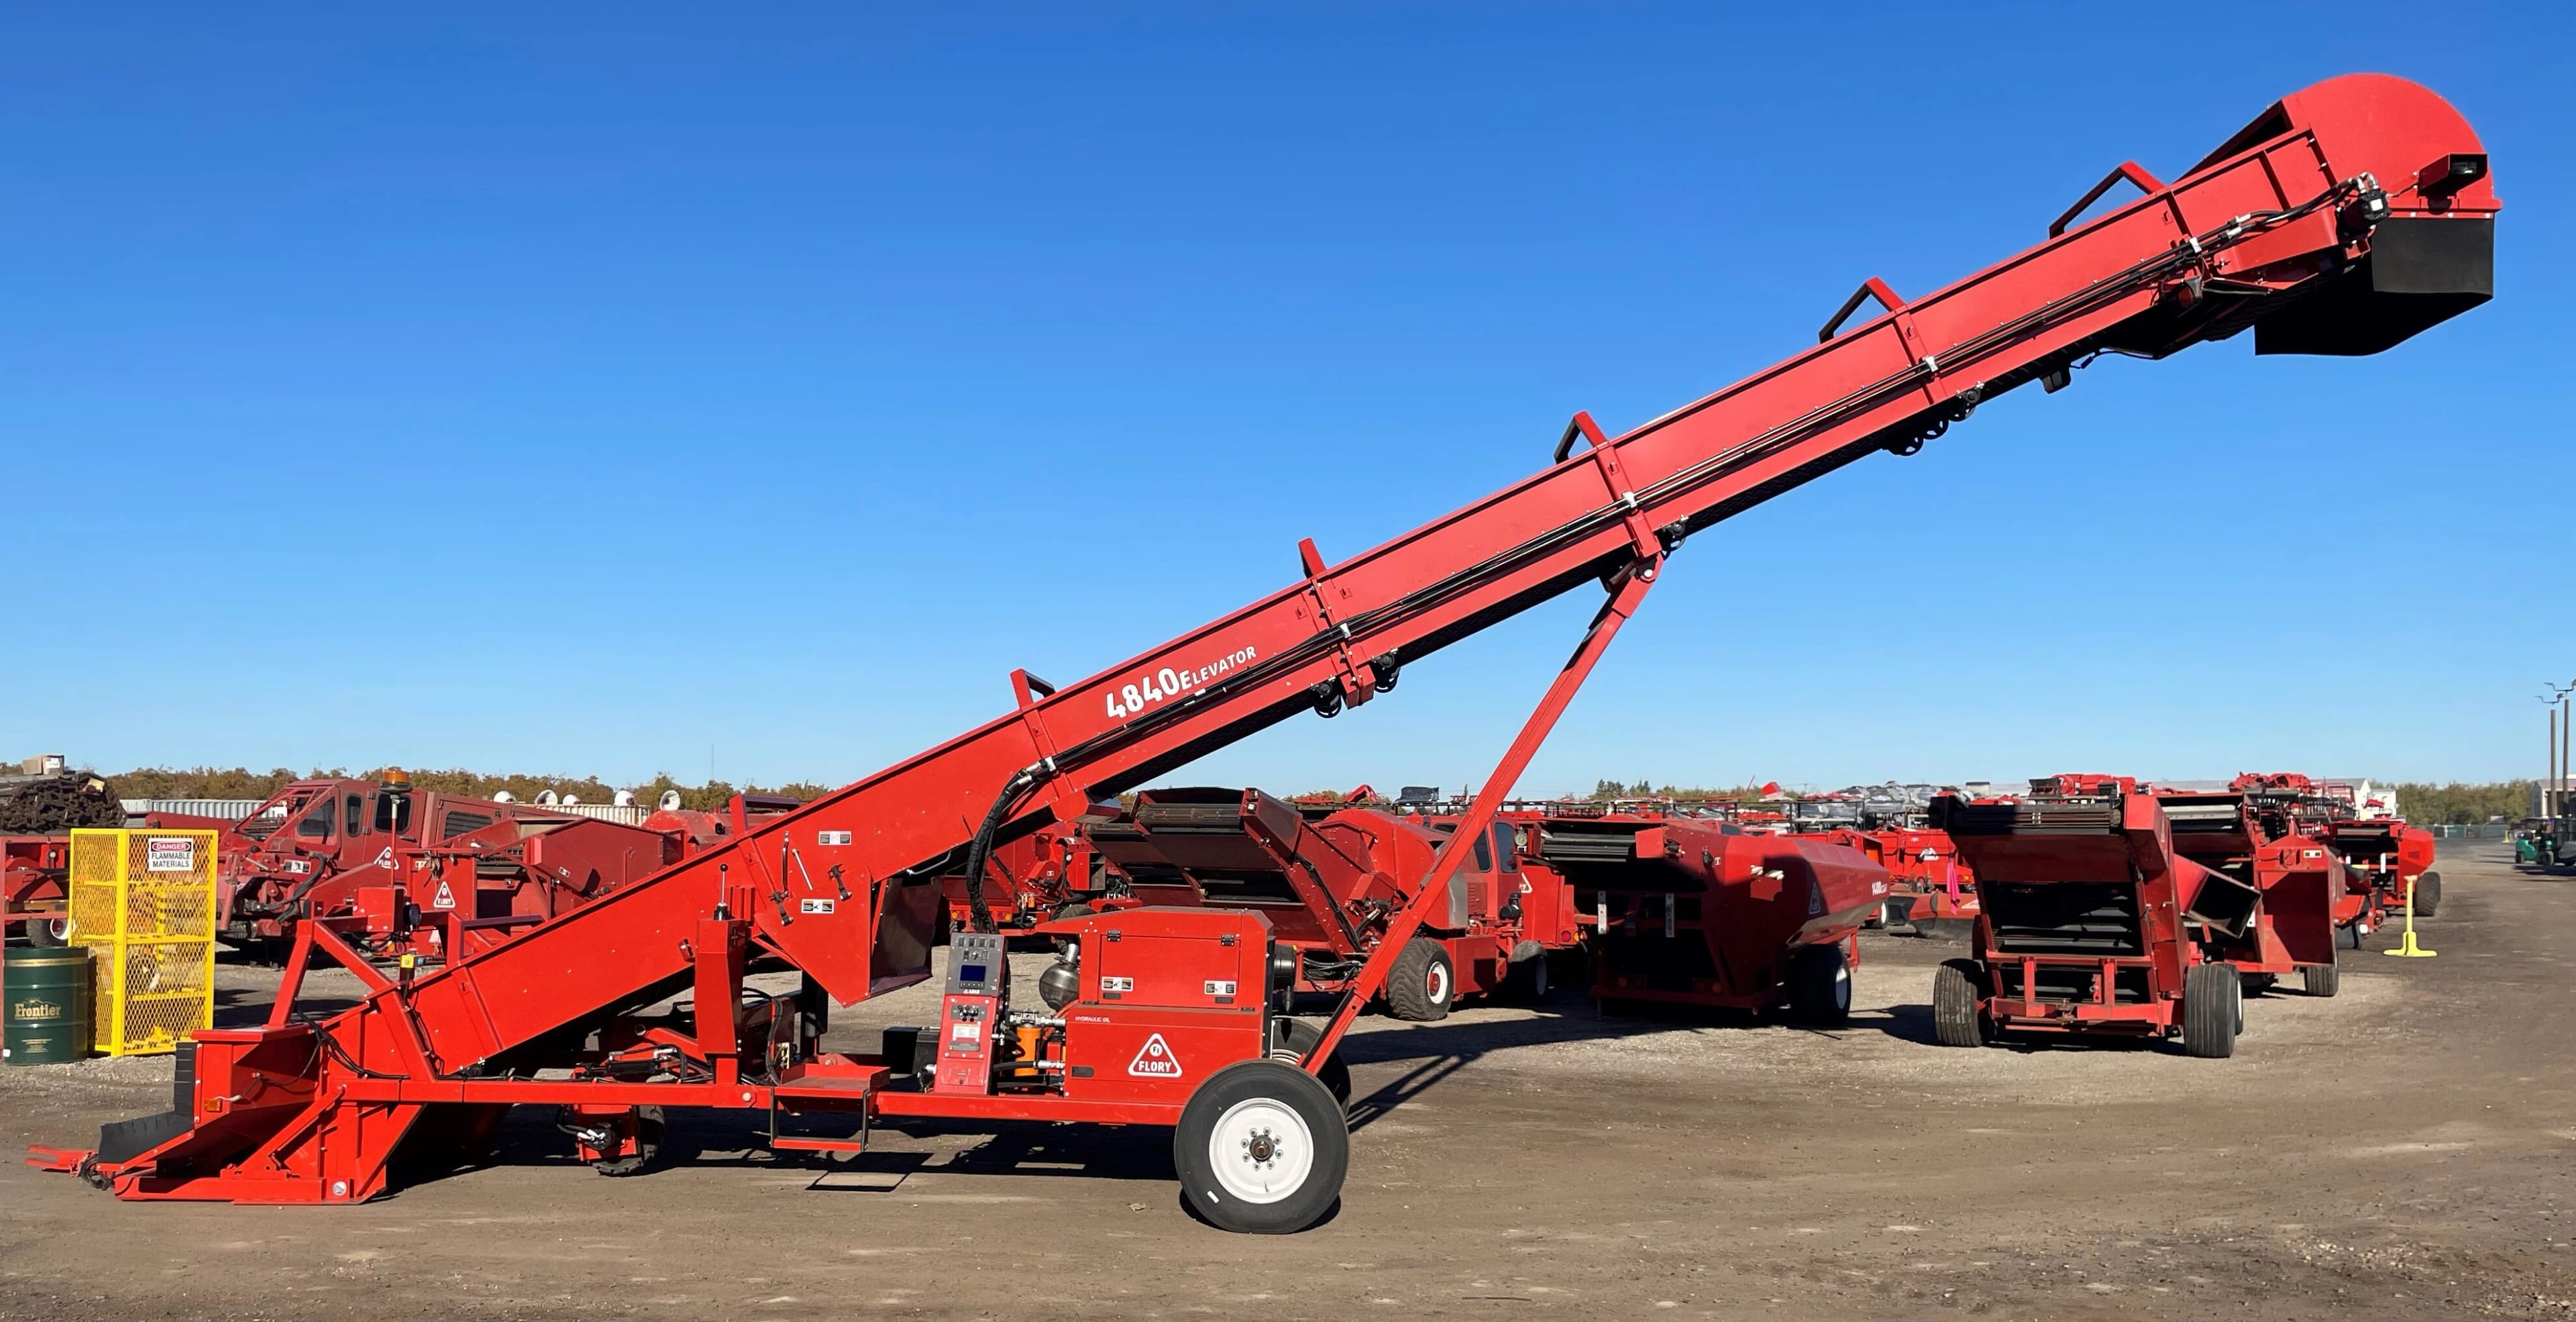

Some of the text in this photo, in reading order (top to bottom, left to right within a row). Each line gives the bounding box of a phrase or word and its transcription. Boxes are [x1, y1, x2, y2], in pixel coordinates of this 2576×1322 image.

[1106, 668, 1180, 718] 4840
[15, 1003, 62, 1019] Frontier
[1138, 1061, 1172, 1072] FLORY
